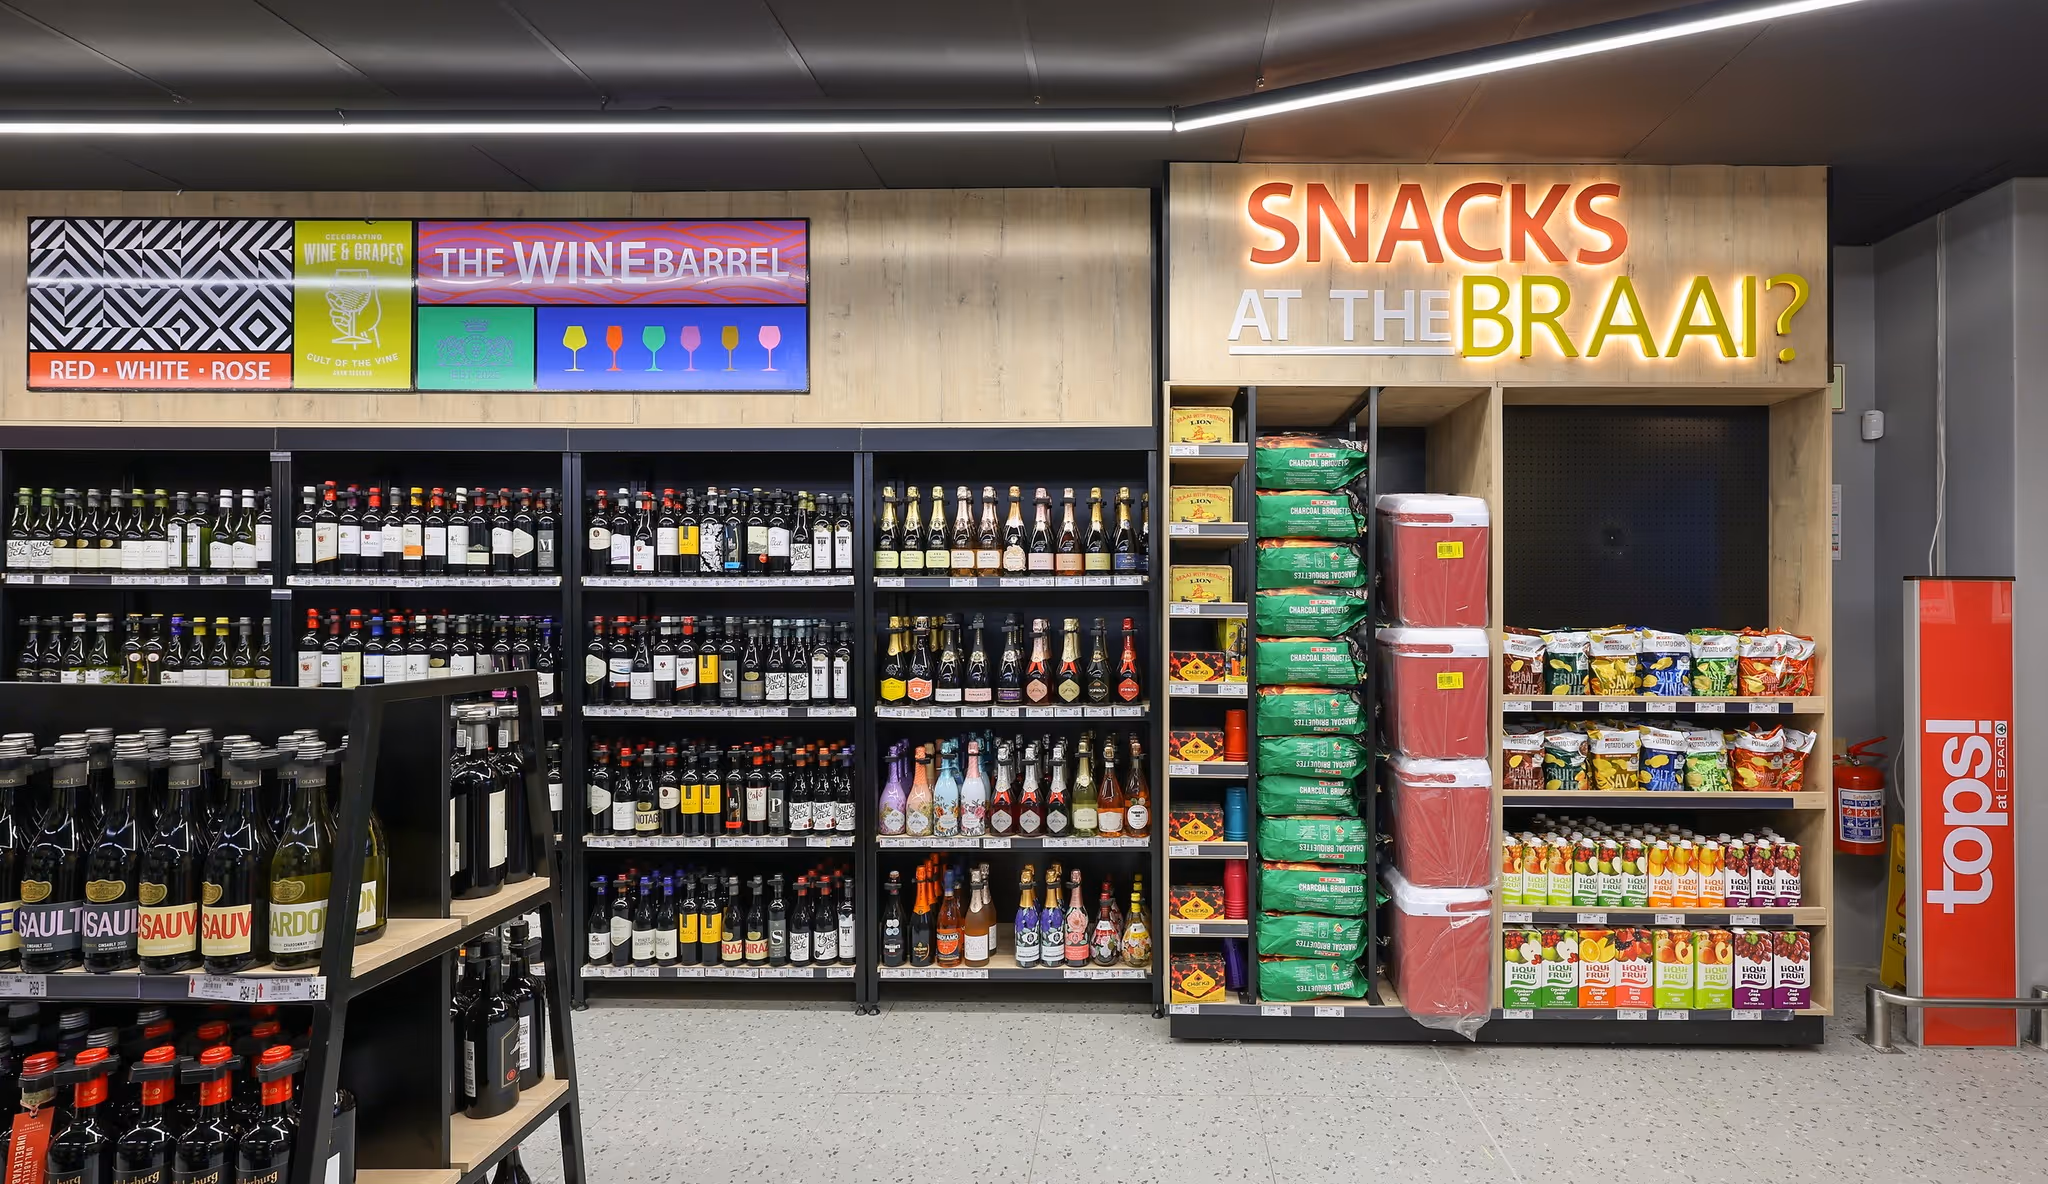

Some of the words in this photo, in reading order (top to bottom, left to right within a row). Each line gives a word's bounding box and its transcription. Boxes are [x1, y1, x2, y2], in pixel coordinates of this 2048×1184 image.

[1247, 182, 1629, 265] SNACKS
[304, 244, 336, 264] WINE
[341, 244, 349, 261] &
[355, 243, 404, 265] GRAPES
[435, 248, 504, 277] THE
[513, 241, 647, 284] WINE
[654, 247, 789, 277] BARREL
[1227, 289, 1301, 342] AT
[1329, 289, 1450, 341] THE
[1461, 273, 1810, 361] BRAAI?
[307, 353, 331, 365] CULT
[352, 359, 371, 367] THE
[375, 353, 399, 365] VINE
[50, 360, 94, 379] RED
[116, 360, 189, 379] WHITE
[212, 360, 270, 380] ROSE
[1289, 459, 1319, 467] CHARCOAL
[1291, 507, 1320, 515] CHARCOAL
[1291, 654, 1320, 662] CHARCOAL
[1553, 673, 1582, 685] FRUIT
[1609, 675, 1628, 689] SAY
[1656, 671, 1674, 682] SALT
[1513, 684, 1538, 695] TIME
[1713, 680, 1726, 690] THE
[1997, 738, 2005, 778] SPAR
[1609, 774, 1629, 787] SAY
[1652, 769, 1670, 780] SALT
[1513, 779, 1538, 789] TIME
[748, 790, 763, 801] Café
[1996, 795, 2007, 809] at
[771, 798, 781, 812] P
[1926, 720, 2008, 913] tops!
[1299, 844, 1334, 852] BRIQUETTES
[1299, 884, 1329, 892] CHARCOAL
[1330, 884, 1363, 893] BRIQUETTES
[202, 911, 252, 939] SAUV
[772, 930, 783, 945] S
[1296, 940, 1331, 949] BRIQUETTES
